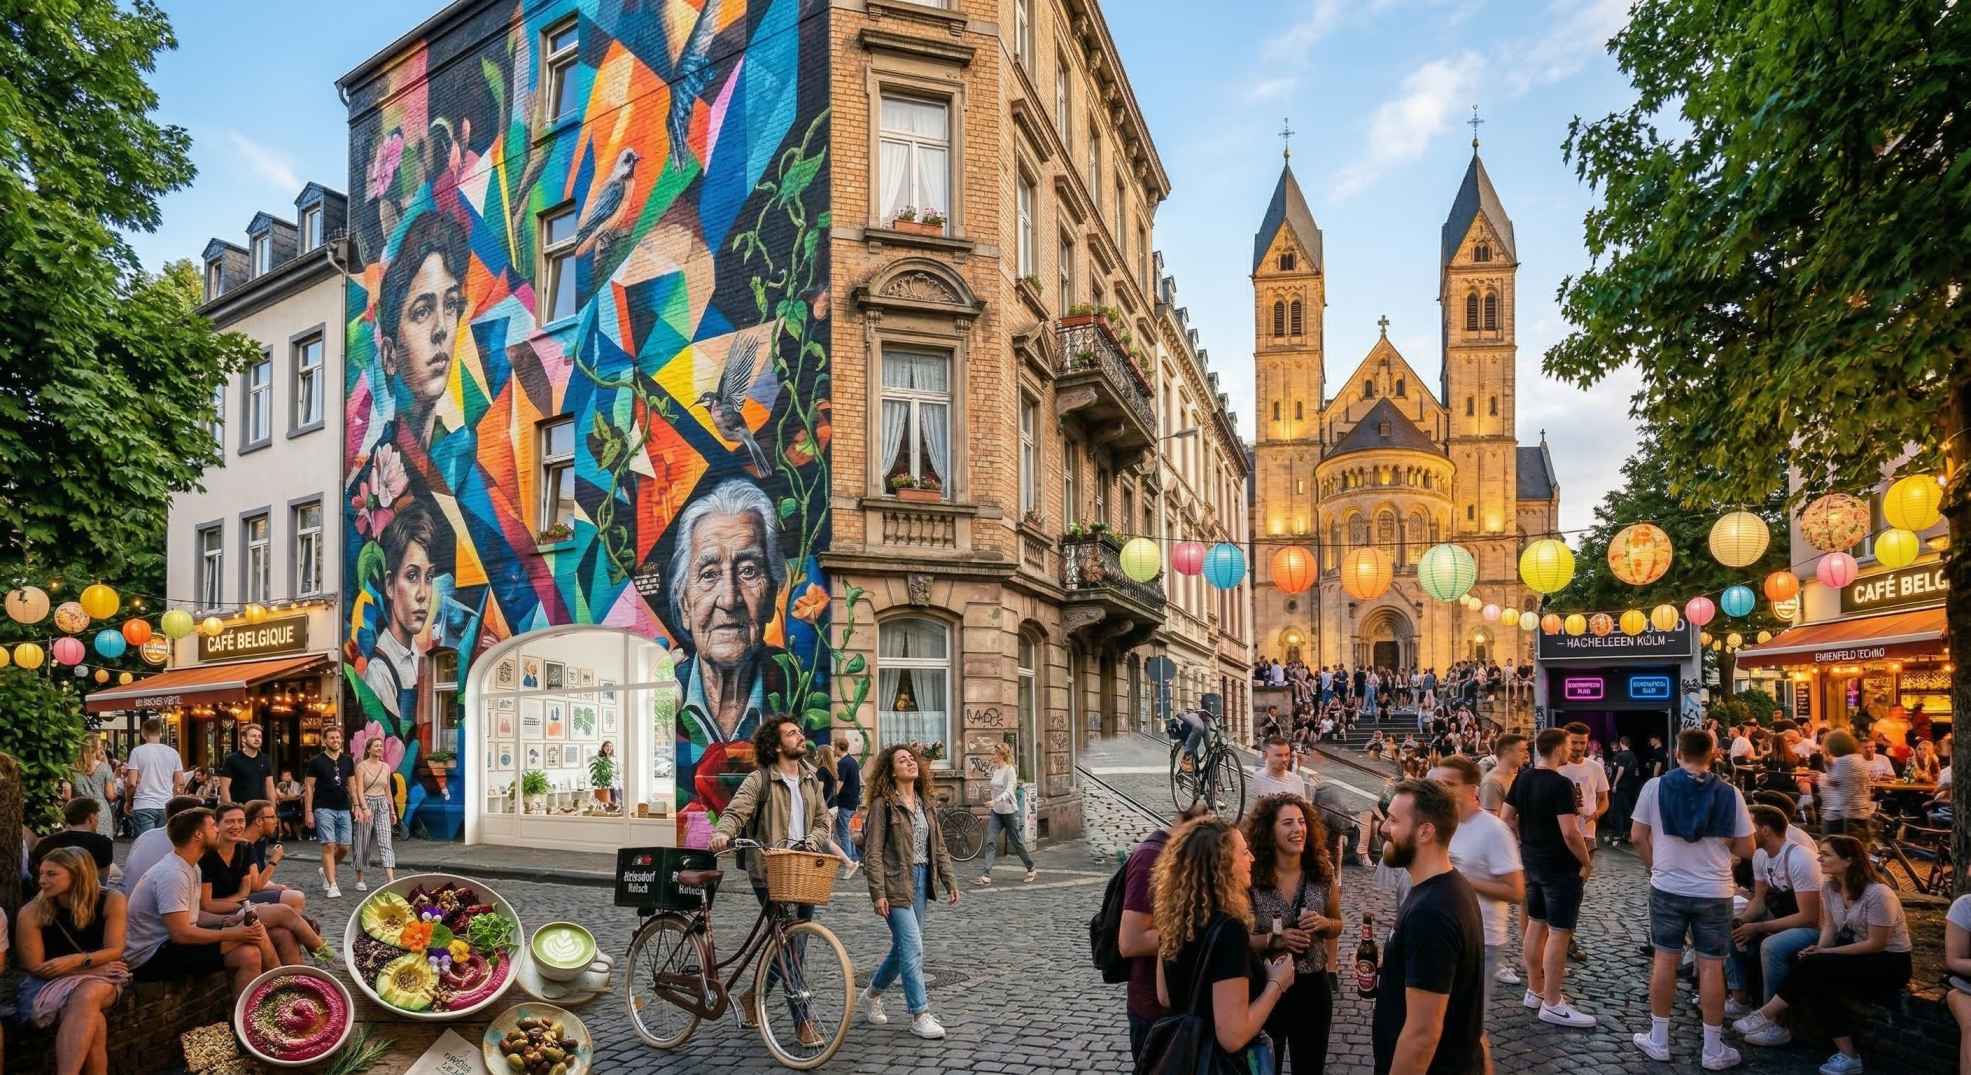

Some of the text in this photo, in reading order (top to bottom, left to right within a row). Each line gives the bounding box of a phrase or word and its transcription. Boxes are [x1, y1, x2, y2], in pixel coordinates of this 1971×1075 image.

[1854, 574, 1896, 604] CAFÉ
[207, 625, 294, 652] CAFÉ BELGIQUE
